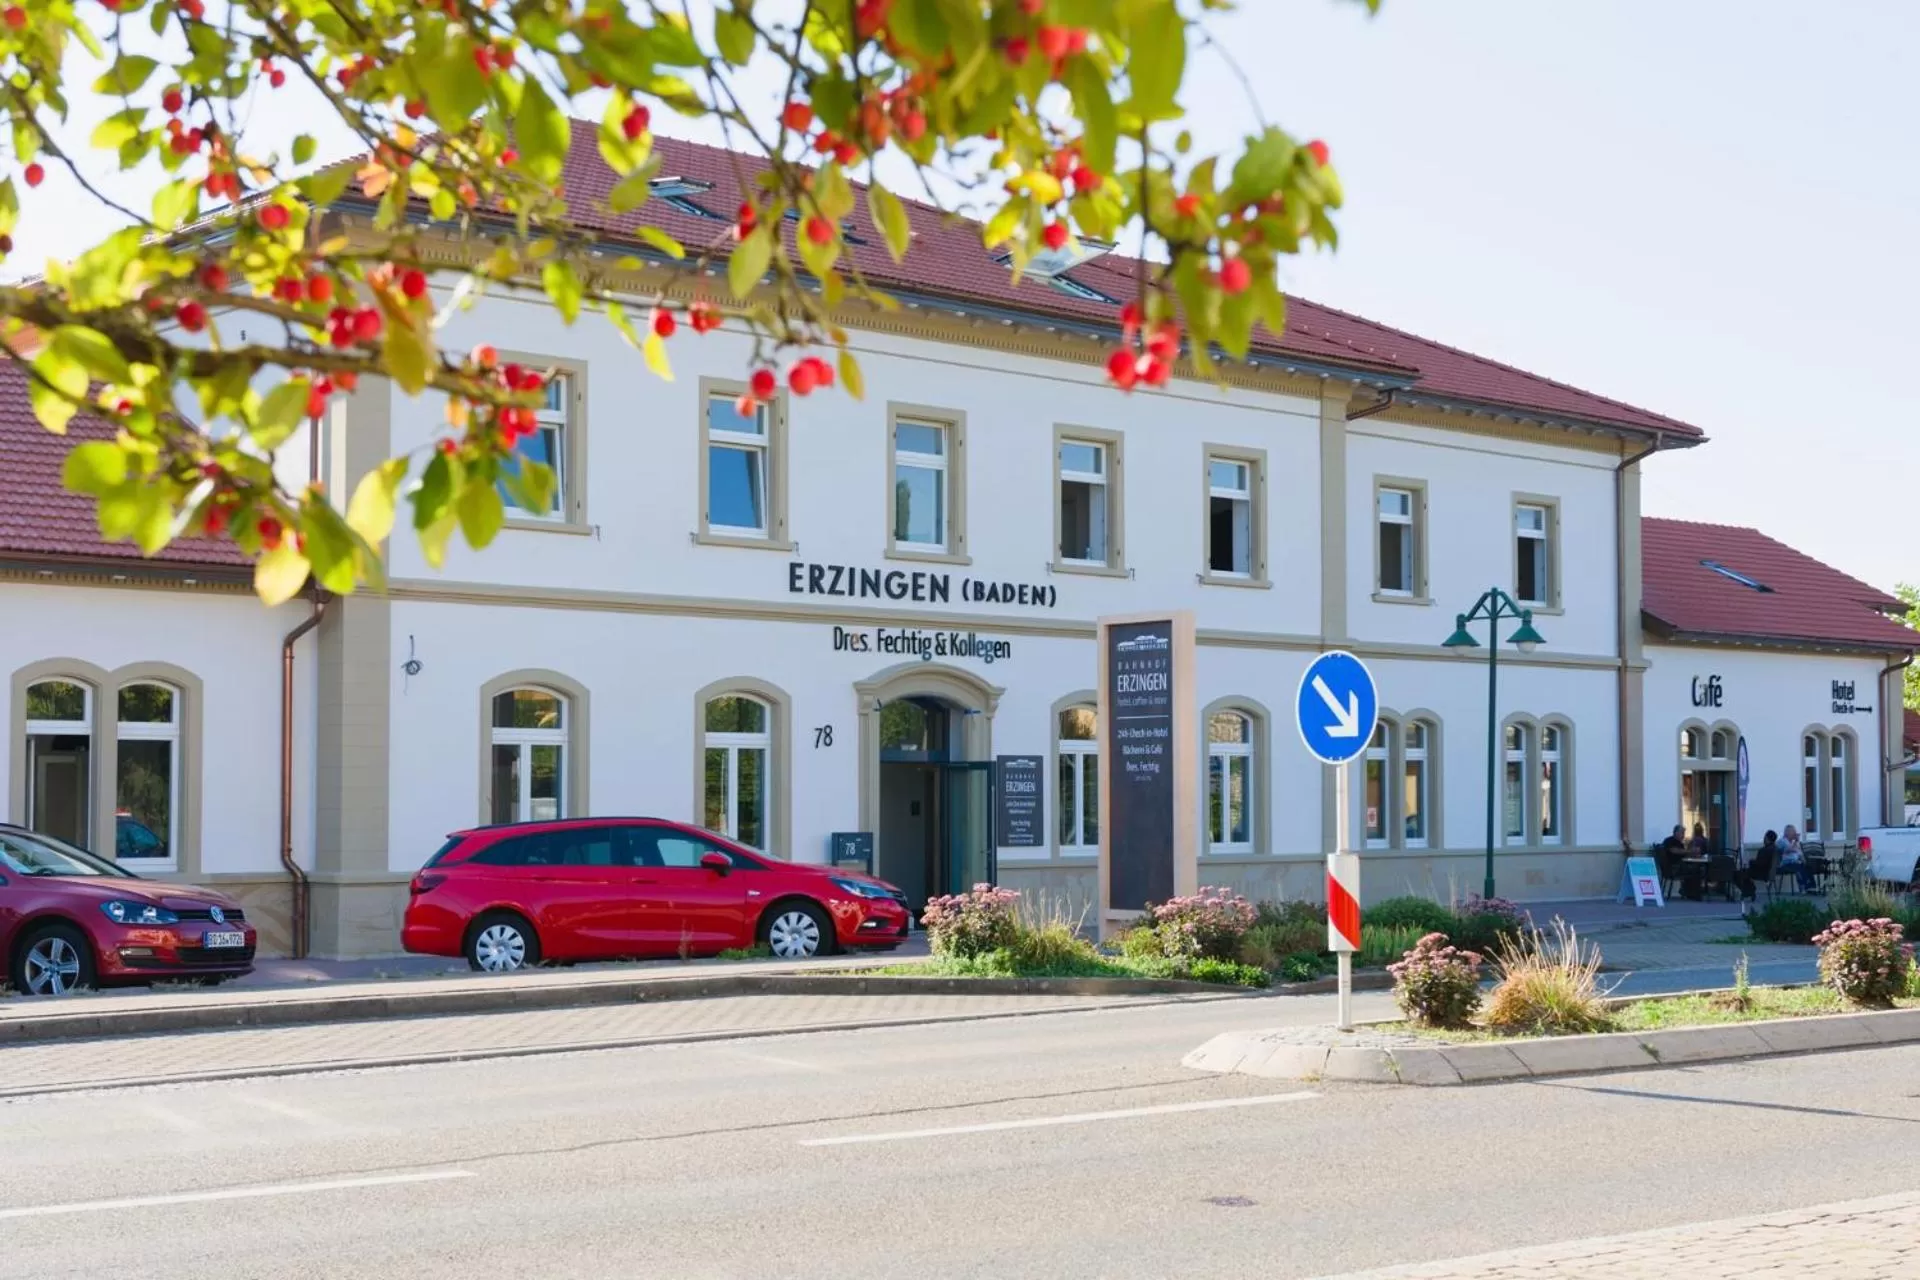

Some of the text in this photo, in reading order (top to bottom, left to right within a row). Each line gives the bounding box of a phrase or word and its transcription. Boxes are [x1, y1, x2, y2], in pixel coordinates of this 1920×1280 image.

[789, 562, 1057, 608] ERZINGEN (BADEN)
[833, 626, 1011, 664] Dres. Fechtig & Kollegen
[1117, 659, 1167, 671] BAHNHOF
[1117, 672, 1168, 693] ERZINGEN
[1692, 675, 1723, 708] Café
[1831, 680, 1855, 701] Hotel
[814, 724, 833, 749] 78
[1005, 781, 1036, 793] ERZINGEN
[845, 842, 856, 856] 78
